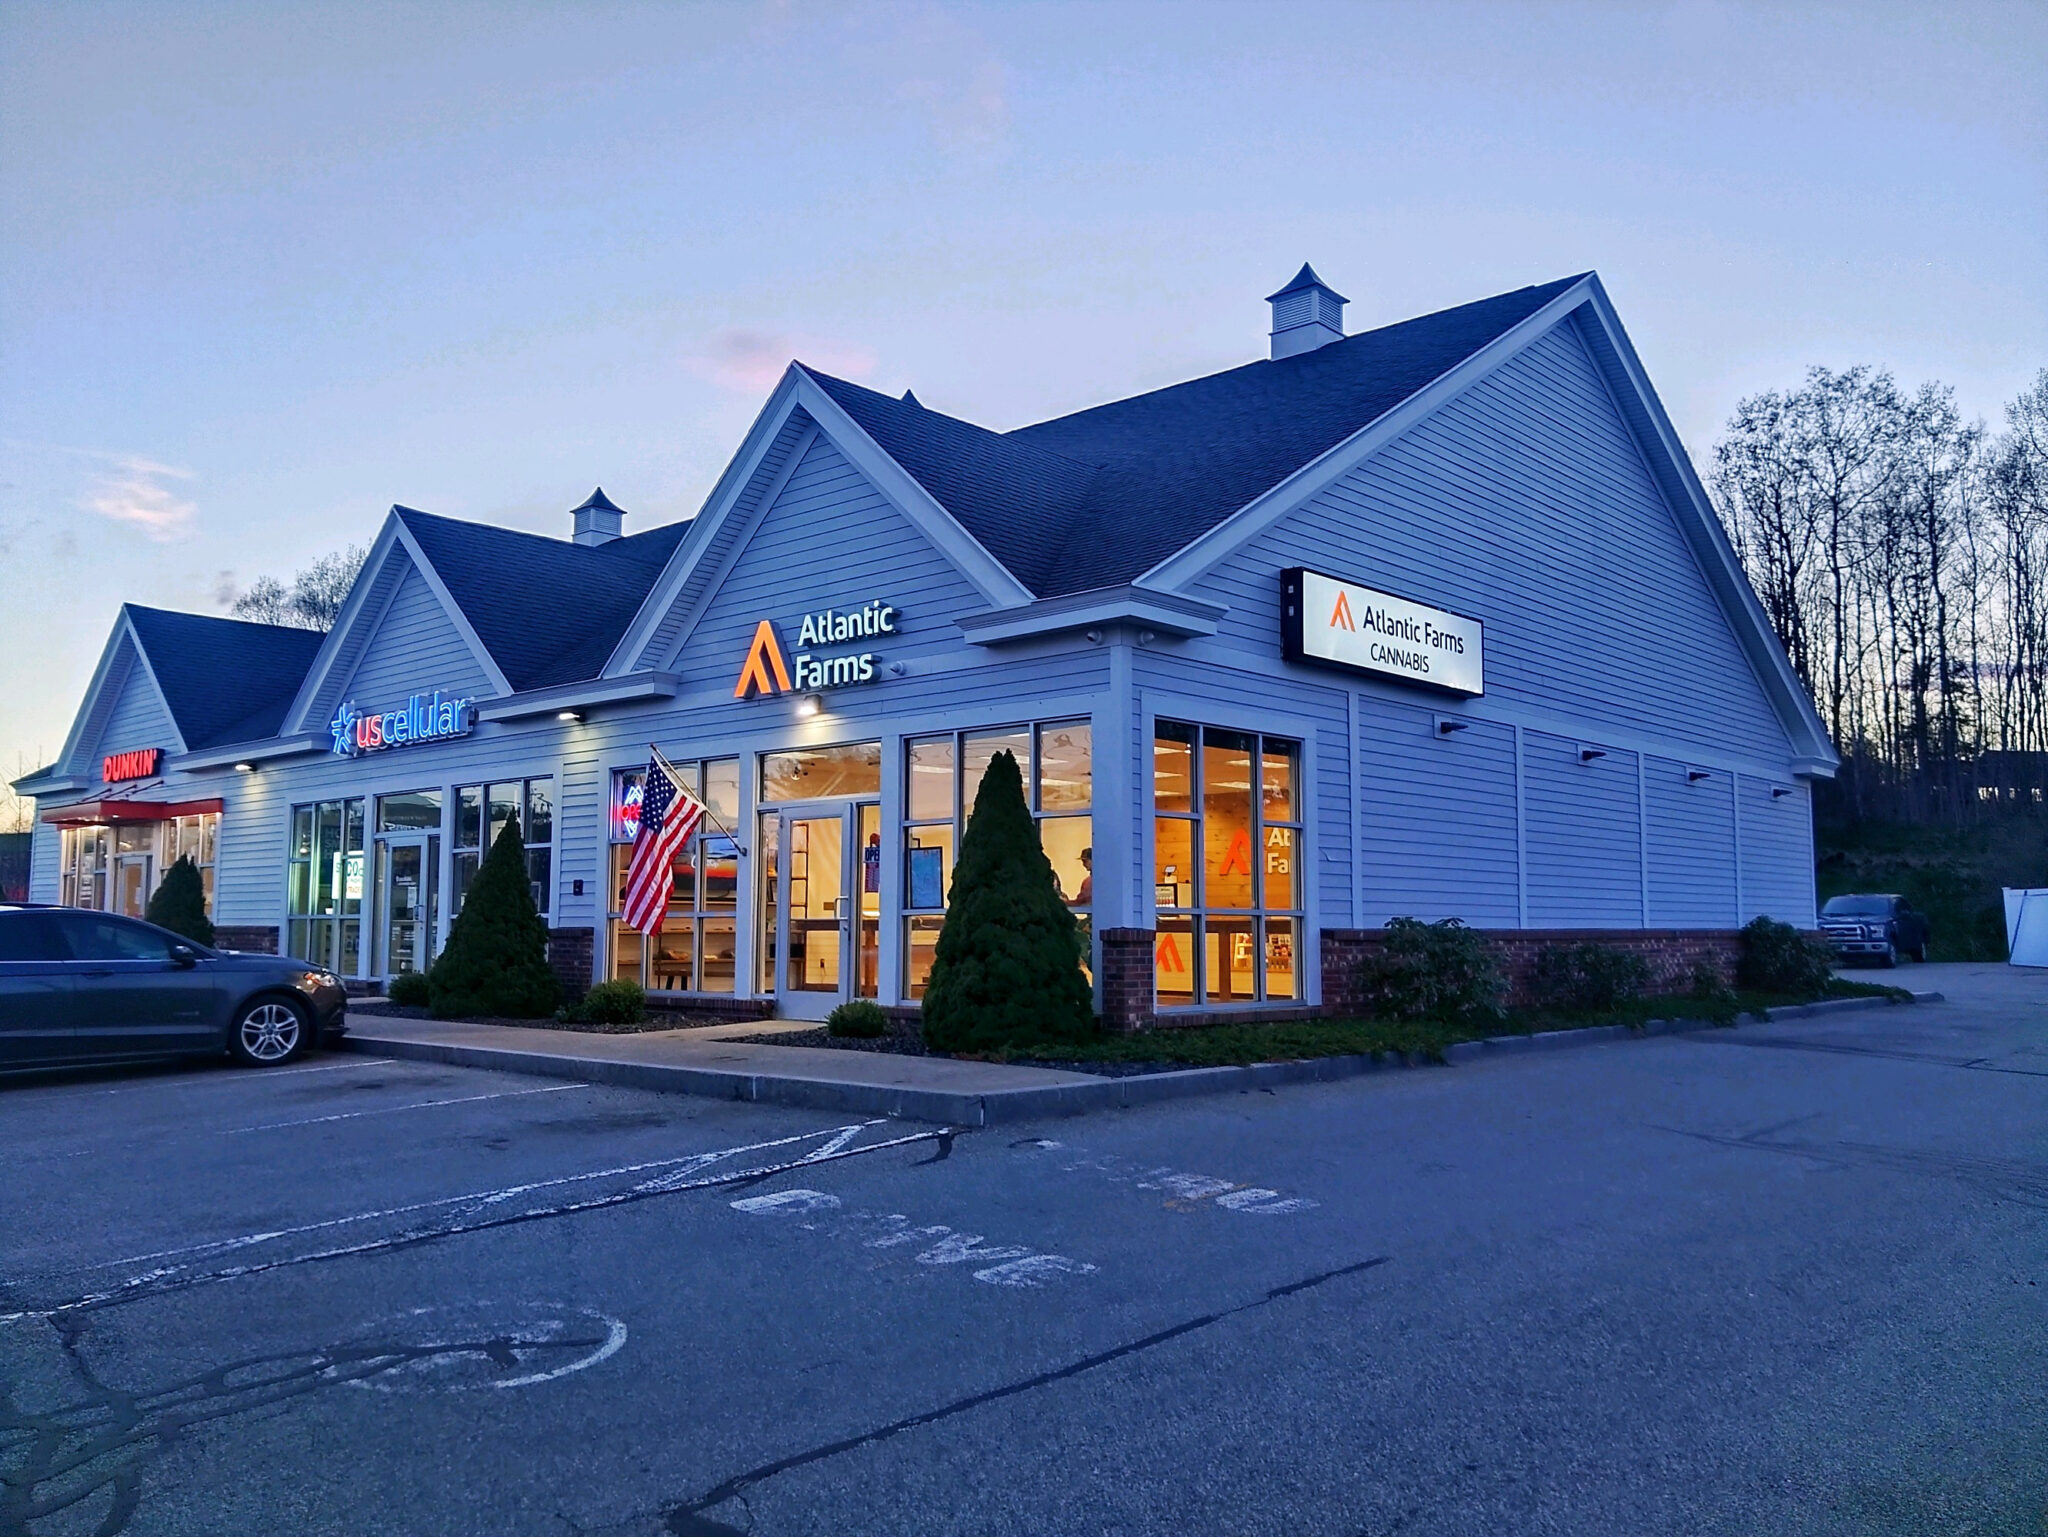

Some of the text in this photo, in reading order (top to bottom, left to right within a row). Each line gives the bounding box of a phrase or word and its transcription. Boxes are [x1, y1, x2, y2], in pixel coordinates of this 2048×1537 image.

[798, 600, 893, 646] Atlantic
[1363, 605, 1464, 654] Atlantic Farms
[795, 653, 873, 689] Farms
[1370, 643, 1430, 673] CANNABIS
[103, 749, 158, 783] DUNKIN'
[621, 803, 641, 820] OPE
[865, 849, 880, 861] OPE
[730, 1189, 1101, 1287] DIVE
